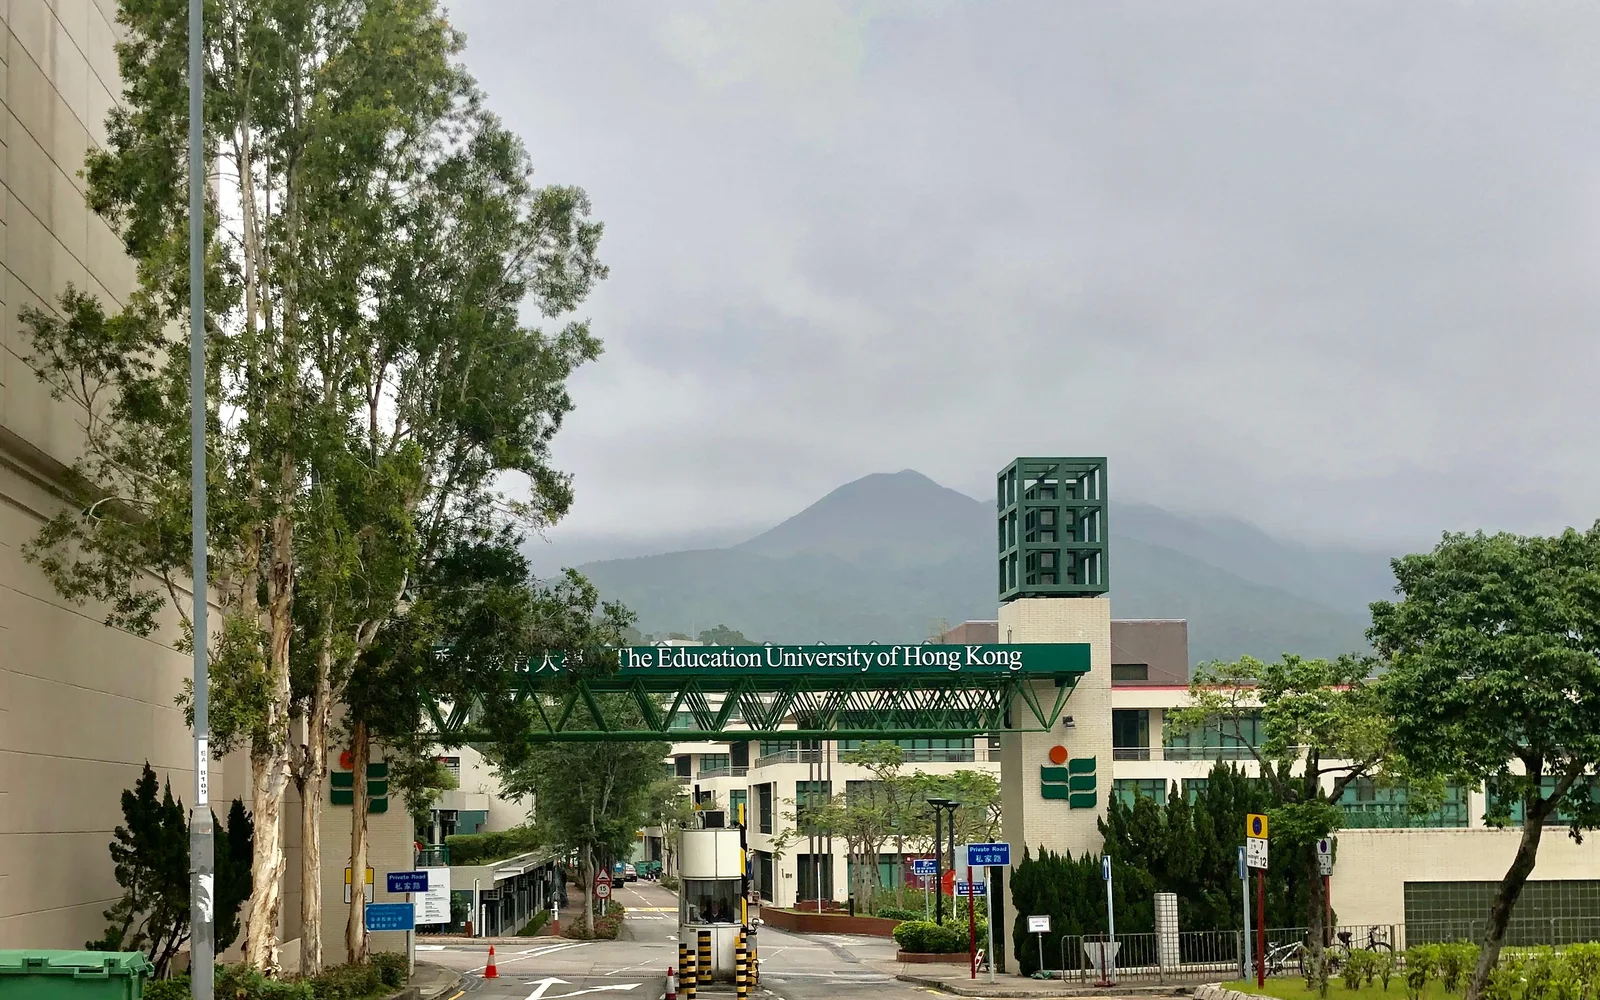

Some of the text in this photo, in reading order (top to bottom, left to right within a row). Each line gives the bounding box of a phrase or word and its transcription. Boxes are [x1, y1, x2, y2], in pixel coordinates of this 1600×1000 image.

[612, 645, 1023, 672] The Education University of Hong Kong
[1259, 840, 1264, 851] 7
[975, 854, 1002, 863] 私家路
[1259, 856, 1267, 867] 12
